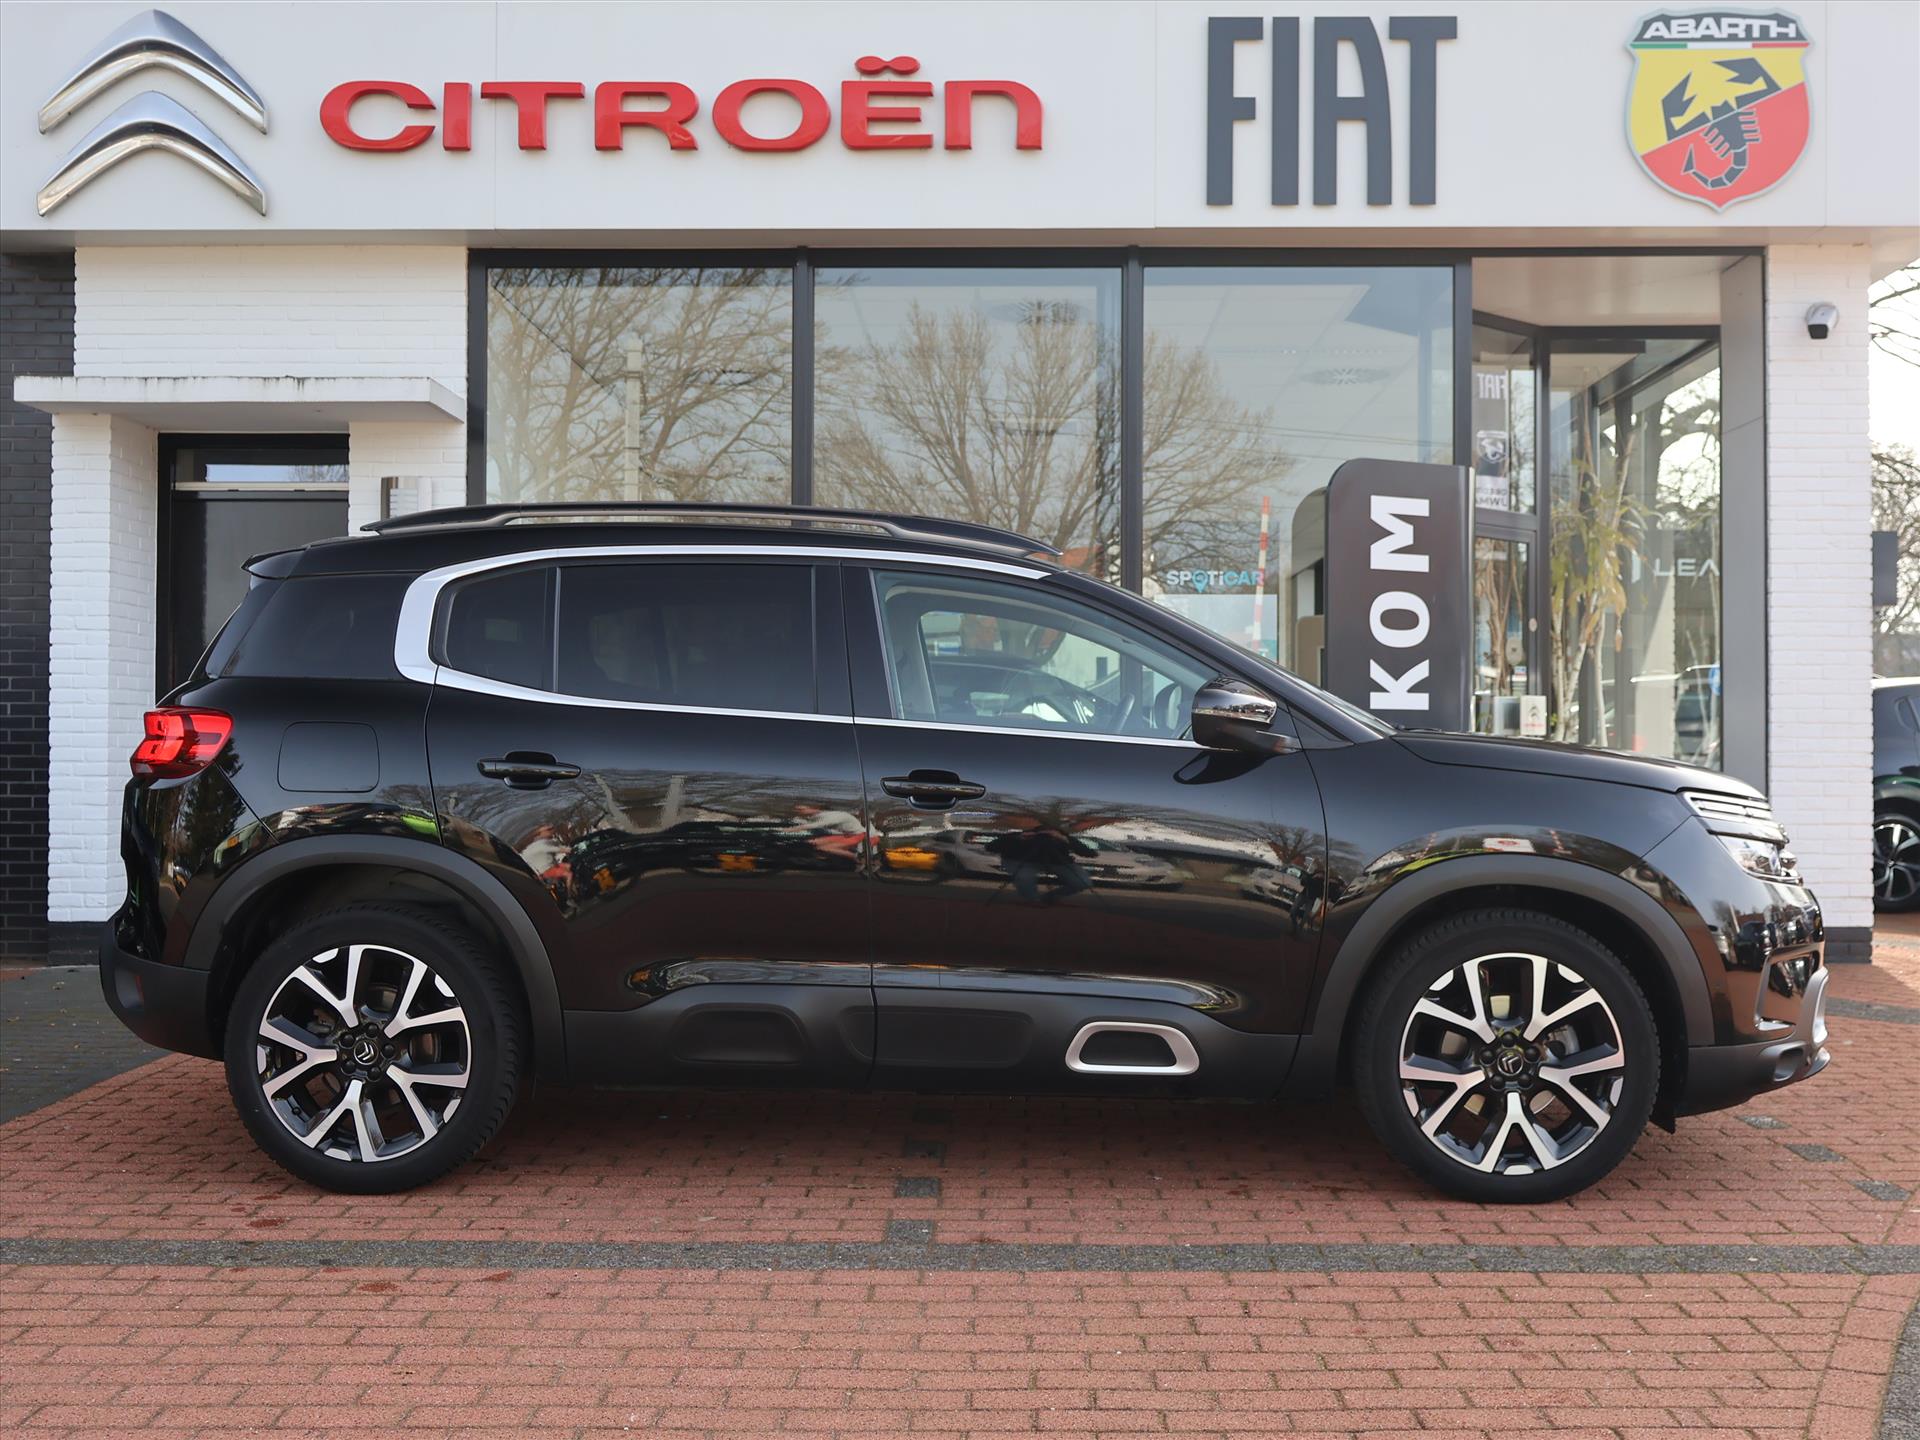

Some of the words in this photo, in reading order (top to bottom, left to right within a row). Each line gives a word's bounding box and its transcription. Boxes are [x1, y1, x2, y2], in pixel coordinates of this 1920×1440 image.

[1643, 17, 1797, 39] ABARTH
[320, 56, 1043, 152] CITROËN
[1207, 16, 1457, 206] FIAT
[1370, 495, 1429, 711] KOM
